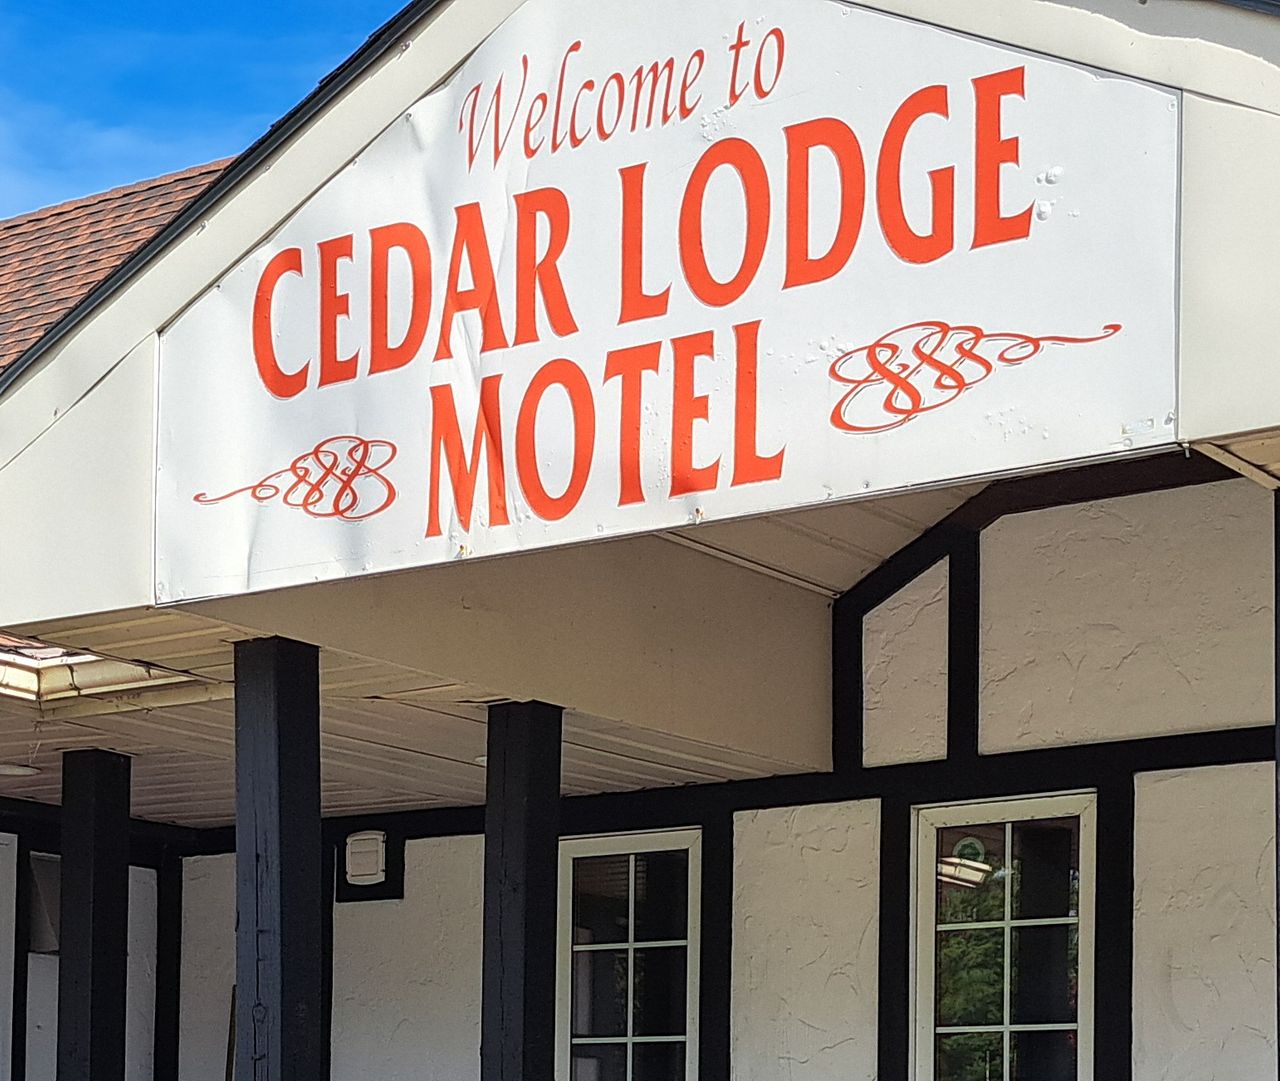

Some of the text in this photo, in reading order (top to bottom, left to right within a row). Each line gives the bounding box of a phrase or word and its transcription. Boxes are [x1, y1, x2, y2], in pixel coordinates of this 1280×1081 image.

[459, 19, 785, 175] Welcome to
[253, 66, 1033, 398] CEDAR LODGE
[426, 320, 785, 537] MOTEL
